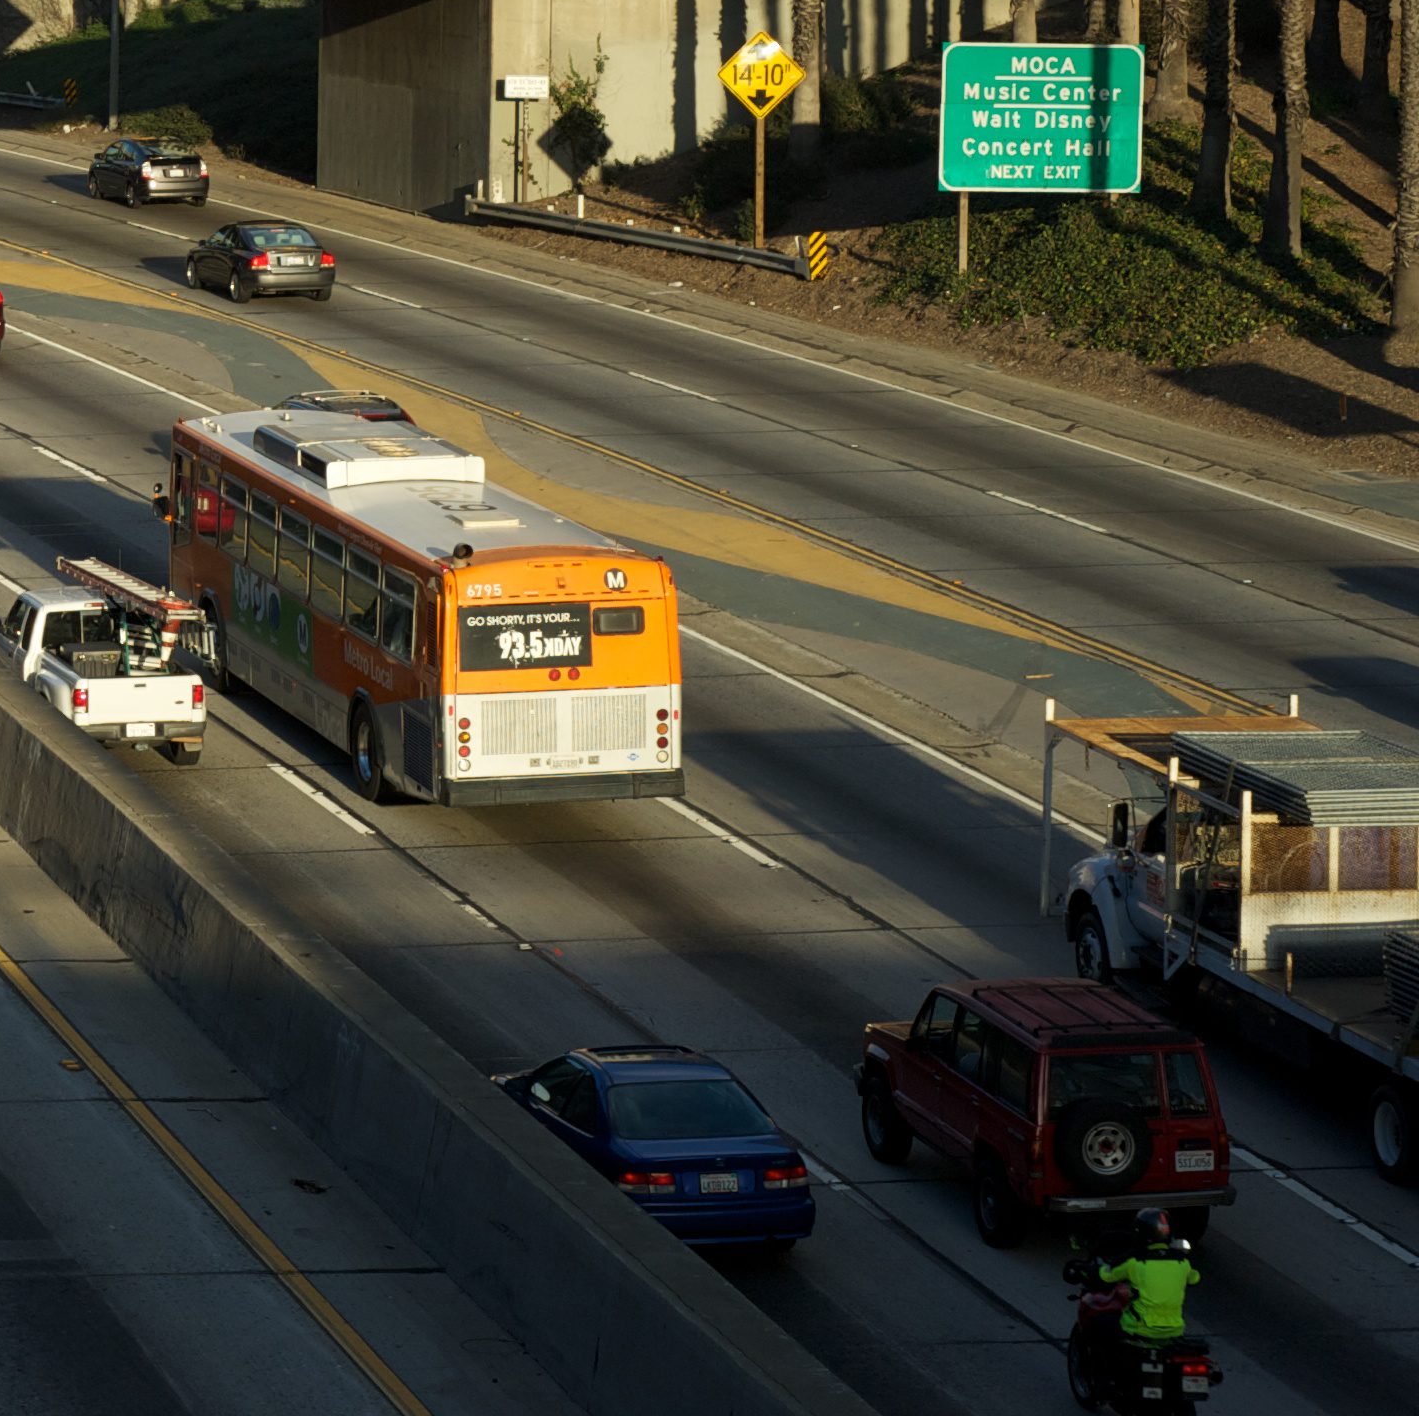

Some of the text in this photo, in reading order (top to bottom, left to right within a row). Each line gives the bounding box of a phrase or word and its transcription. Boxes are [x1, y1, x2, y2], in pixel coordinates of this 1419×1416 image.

[732, 63, 791, 86] 14'-10"
[1011, 56, 1076, 75] MOCA
[963, 83, 1122, 103] Music Center
[972, 110, 1111, 133] Walt Disney
[962, 138, 1111, 157] Concert Hall
[989, 165, 1081, 180] NEXT EXIT
[606, 571, 625, 589] M
[466, 584, 502, 598] 6795
[467, 617, 485, 627] GO
[487, 614, 525, 626] SHORTY,
[527, 614, 542, 624] IT'S
[344, 640, 394, 691] Metro Local
